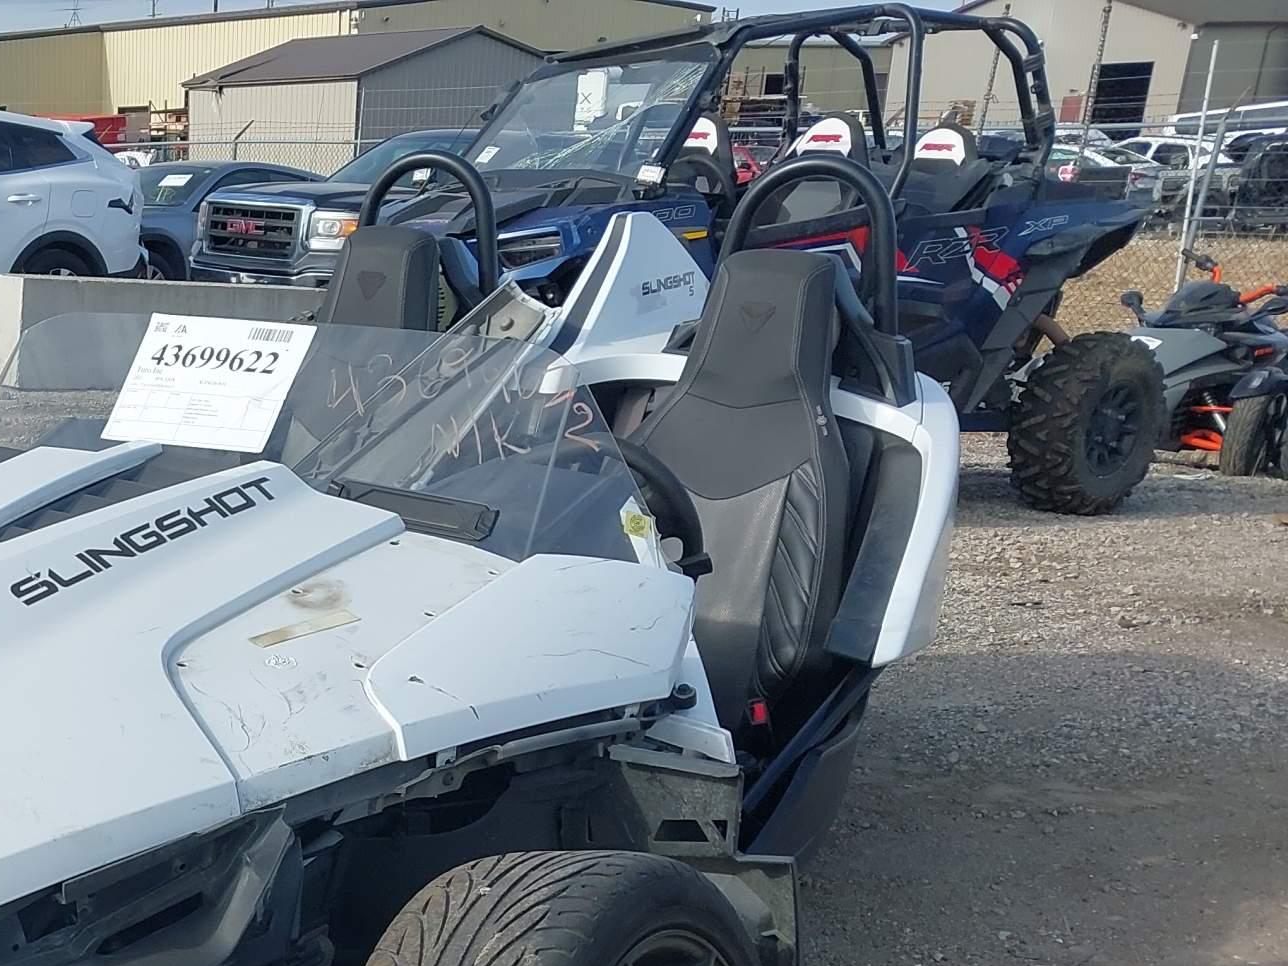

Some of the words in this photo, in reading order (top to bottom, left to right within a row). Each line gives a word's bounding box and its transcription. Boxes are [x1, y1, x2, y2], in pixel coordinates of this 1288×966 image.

[226, 218, 265, 235] GMC
[1018, 215, 1069, 236] XP
[902, 226, 1010, 273] RZR
[642, 271, 695, 297] SLINGSHOT
[151, 343, 280, 375] 43699622
[10, 476, 276, 606] SLINGSHOT
